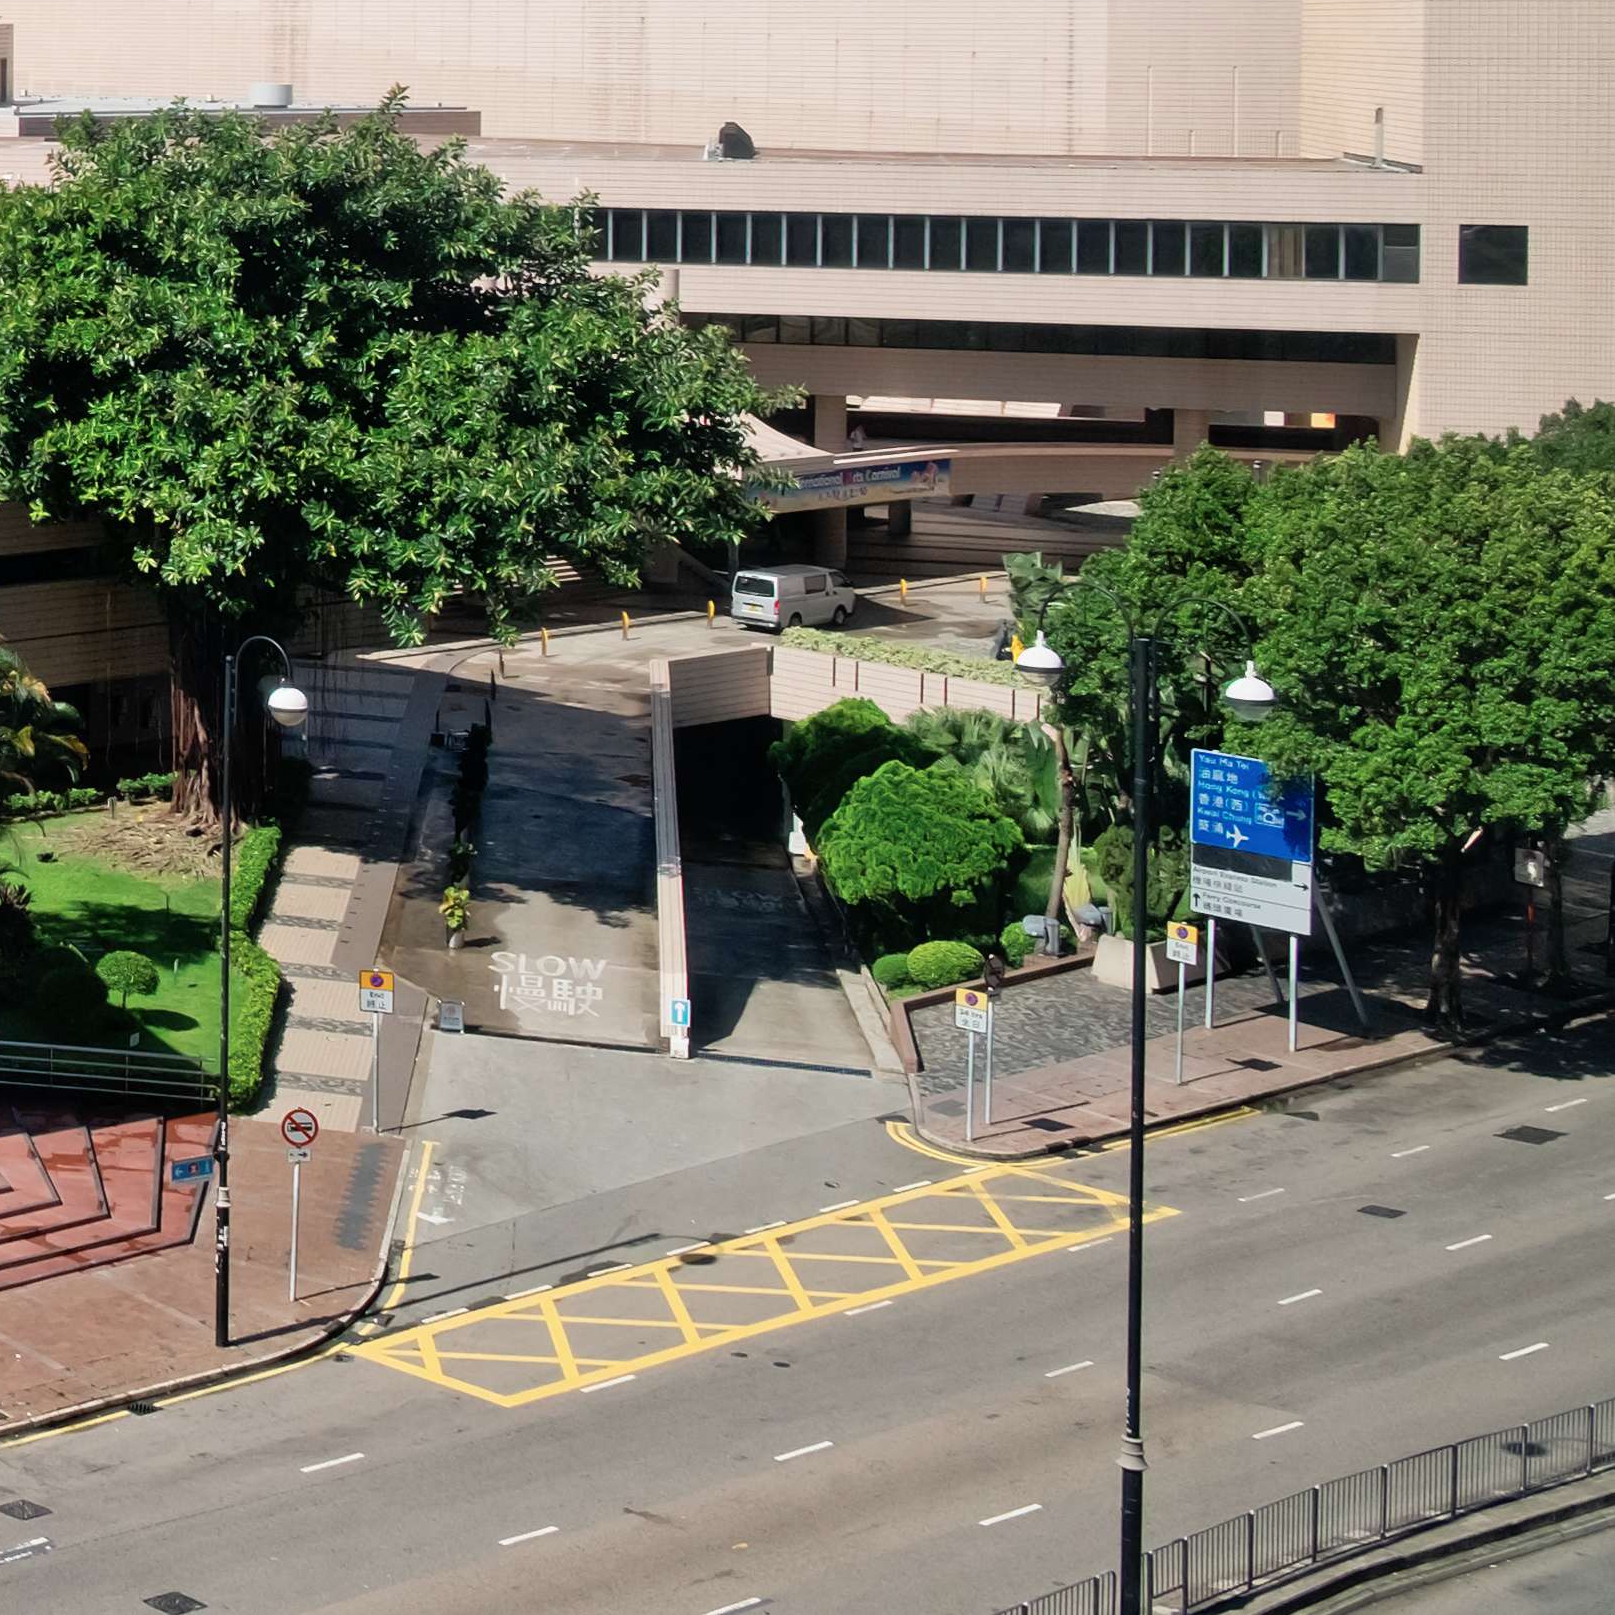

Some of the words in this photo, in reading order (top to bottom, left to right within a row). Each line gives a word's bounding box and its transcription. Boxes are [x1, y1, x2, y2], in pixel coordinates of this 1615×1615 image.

[1198, 754, 1216, 765] Yau
[1219, 758, 1233, 767] Ma
[1236, 760, 1249, 770] Tei
[1197, 780, 1222, 793] Hong
[1226, 785, 1249, 798] Kong
[1197, 807, 1220, 817] Kwai
[1222, 811, 1252, 825] Chung
[487, 951, 608, 980] SLOW
[493, 974, 604, 1018] 慢駛
